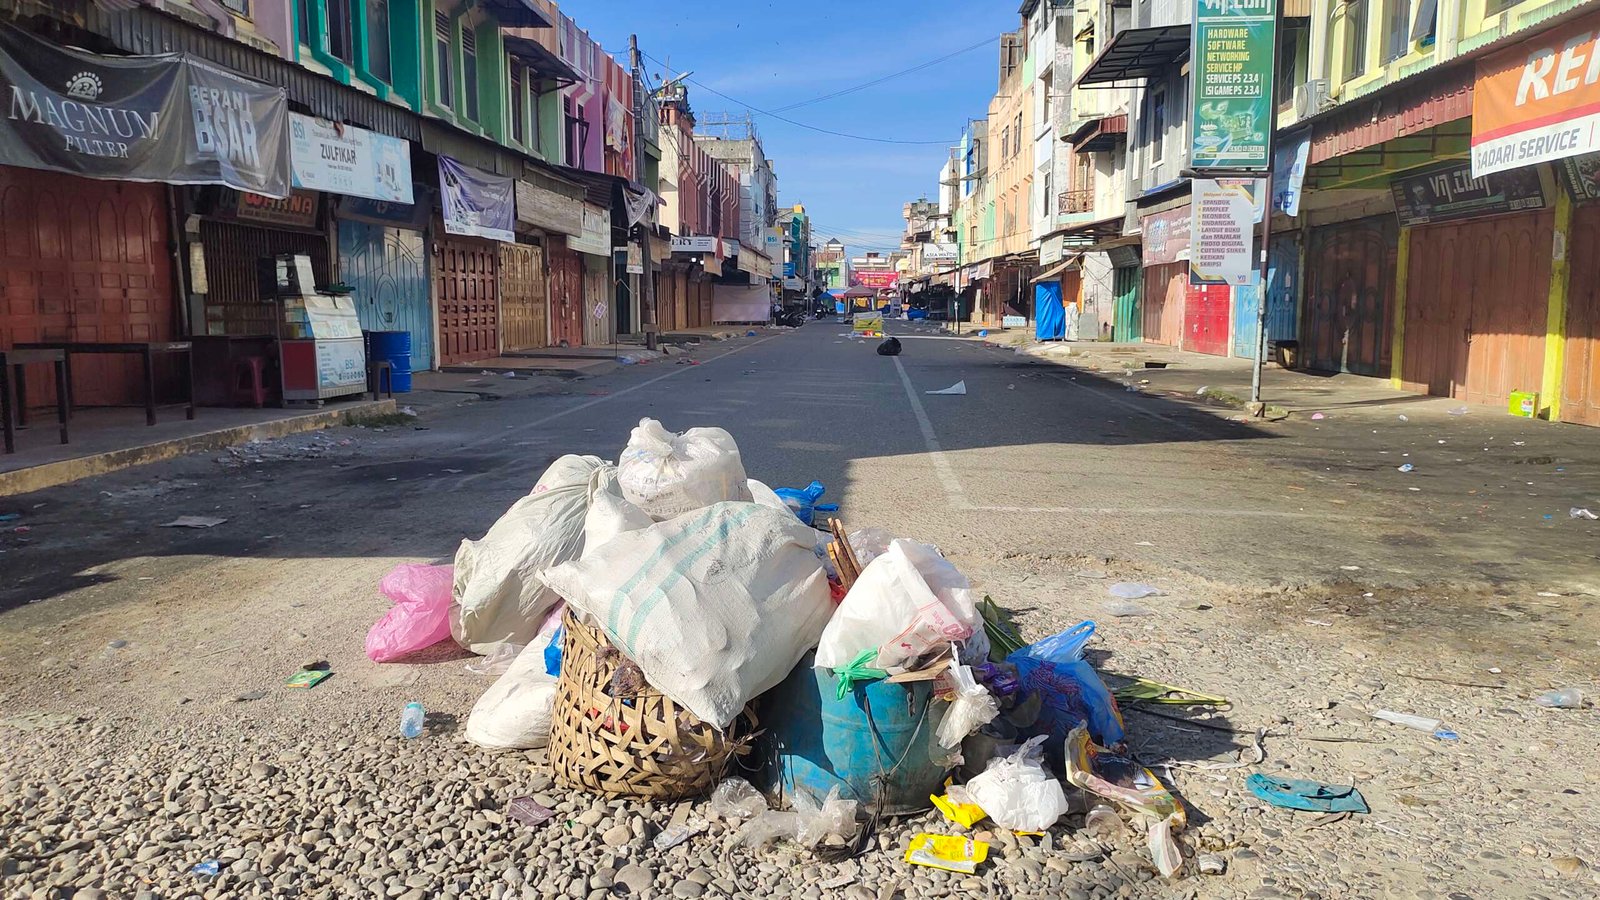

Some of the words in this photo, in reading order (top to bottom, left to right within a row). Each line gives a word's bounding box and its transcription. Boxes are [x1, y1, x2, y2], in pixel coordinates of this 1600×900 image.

[1207, 28, 1249, 39] HARDWARE
[1207, 40, 1246, 51] SOFTWARE
[1206, 51, 1250, 62] NETWORKING
[1206, 62, 1233, 73] SERVICE
[1233, 62, 1243, 73] HP
[1206, 73, 1232, 84] SERVICE
[1232, 73, 1242, 83] PS
[1205, 85, 1214, 96] ISI
[1214, 85, 1234, 96] GAME
[1233, 85, 1242, 95] PS
[188, 84, 251, 113] BERANI
[8, 84, 160, 141] MAGNUM
[292, 120, 306, 140] BSI
[63, 134, 129, 159] FILTER
[1518, 127, 1581, 160] SERVICE
[320, 143, 357, 166] ZULFIKAR
[345, 359, 355, 370] BSI
